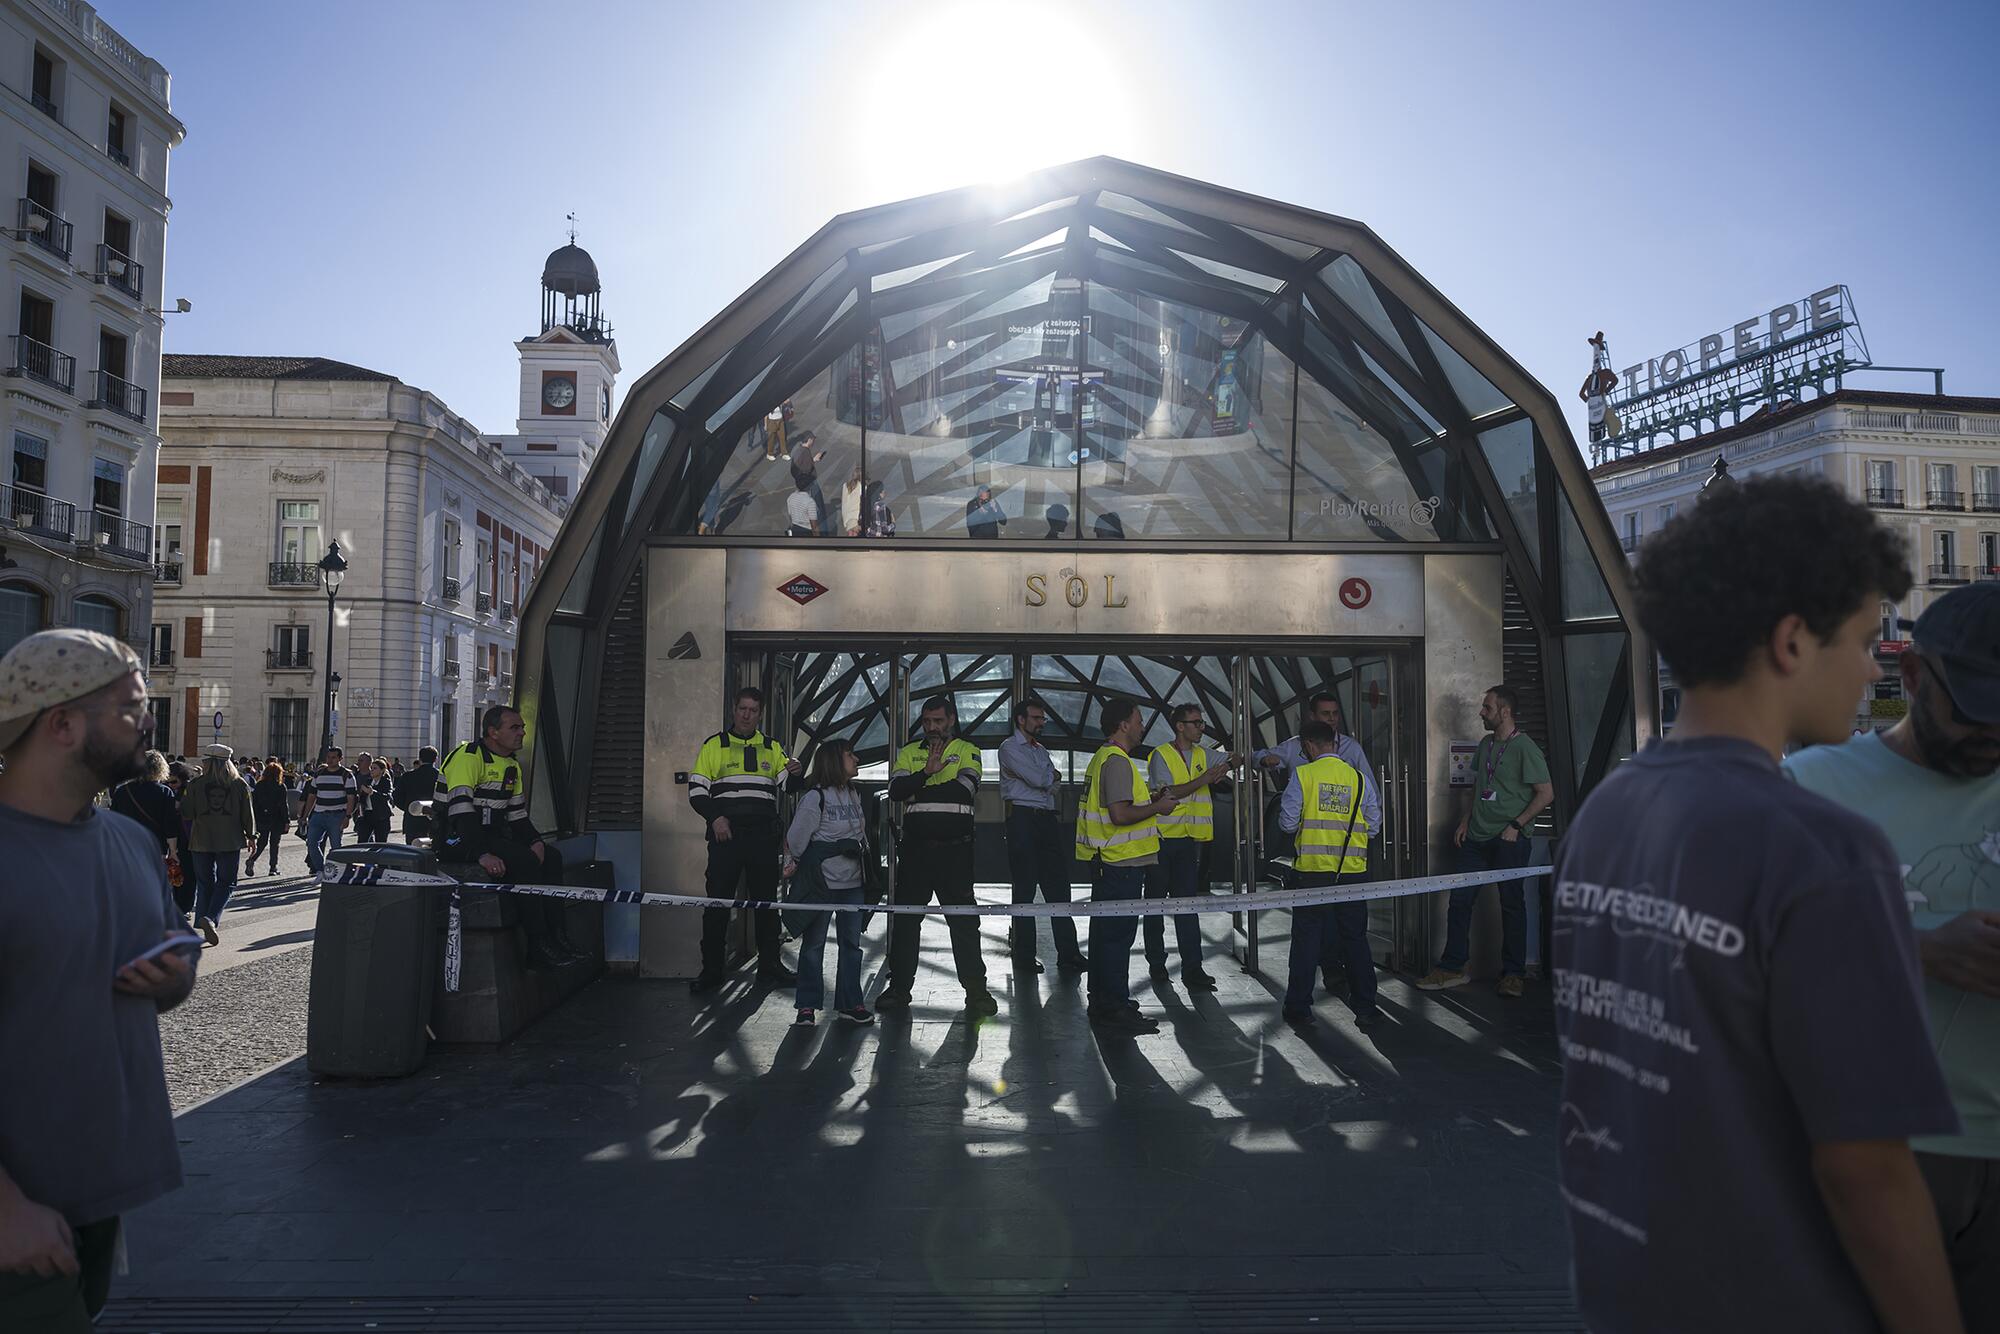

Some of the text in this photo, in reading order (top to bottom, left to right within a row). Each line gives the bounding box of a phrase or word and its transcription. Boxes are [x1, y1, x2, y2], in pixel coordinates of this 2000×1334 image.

[1622, 284, 1841, 398] TIO PEPE
[790, 585, 814, 593] Metro
[1024, 572, 1129, 608] SOL
[1321, 784, 1349, 794] METRO
[1320, 803, 1349, 813] MADRID
